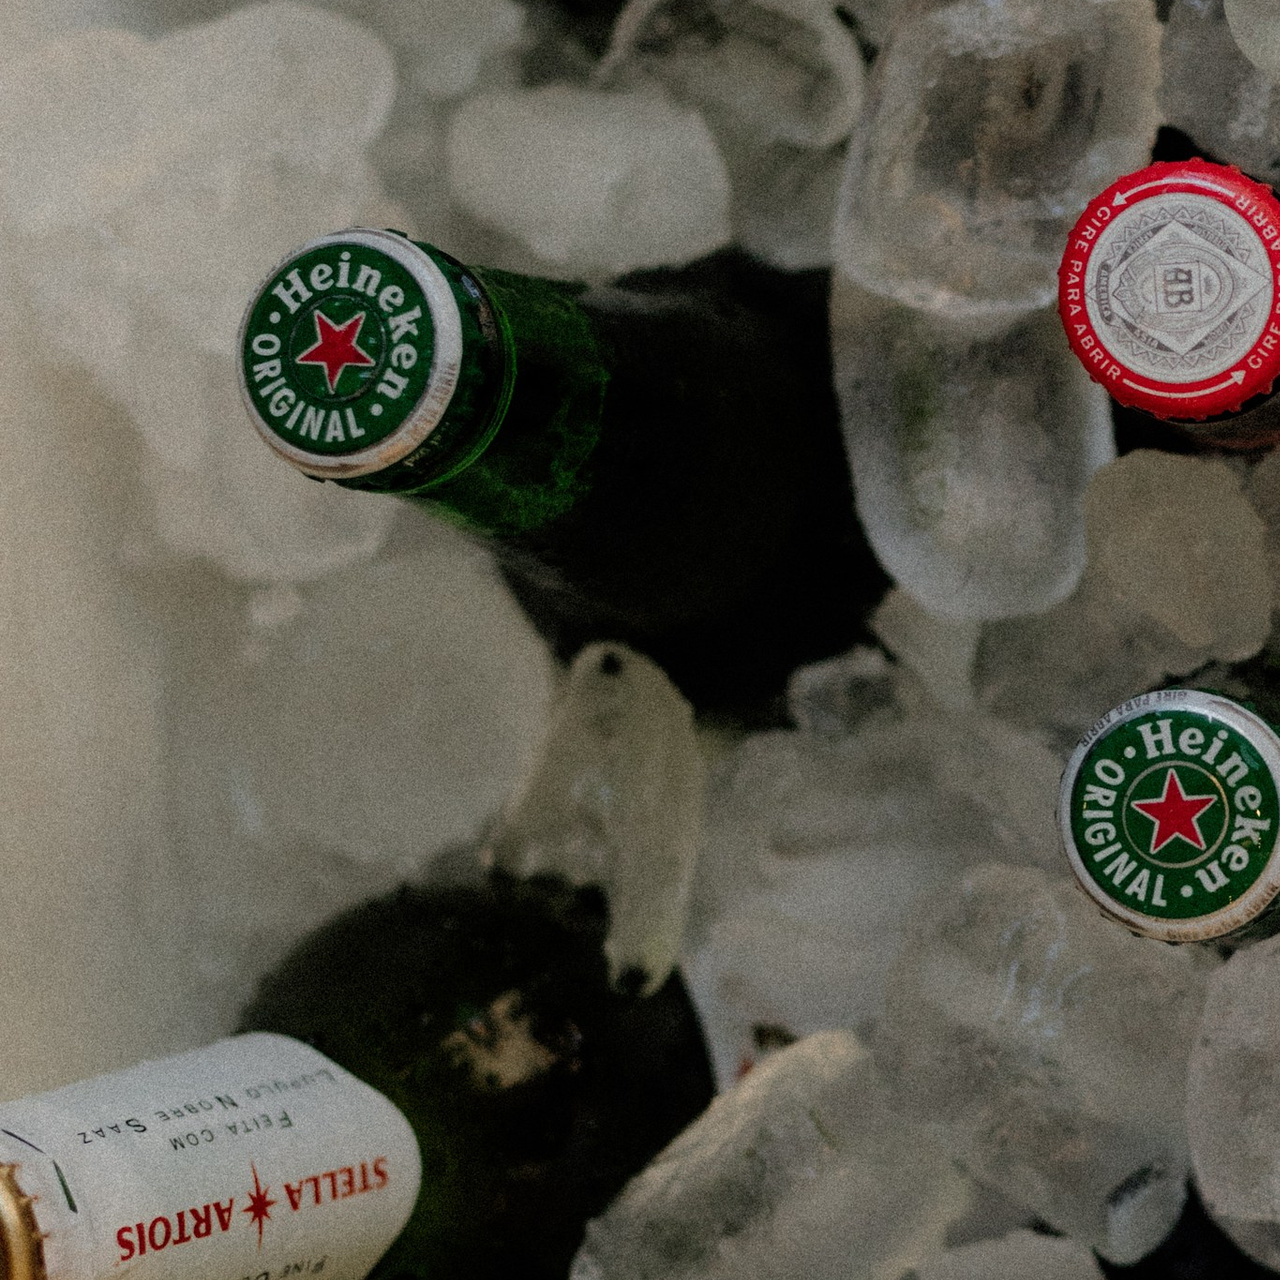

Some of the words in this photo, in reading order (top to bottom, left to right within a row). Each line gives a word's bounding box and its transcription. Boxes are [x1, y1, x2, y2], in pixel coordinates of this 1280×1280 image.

[1074, 203, 1112, 252] GIRE
[1066, 258, 1083, 316] PARA
[274, 251, 420, 401] Heineken
[1072, 321, 1122, 381] ABRIR
[251, 332, 367, 444] ORIGINAL
[1082, 757, 1168, 907] ORIGINAL
[1136, 719, 1271, 893] Heineken
[283, 1156, 390, 1212] STELLA
[116, 1198, 235, 1261] ARTOIS
